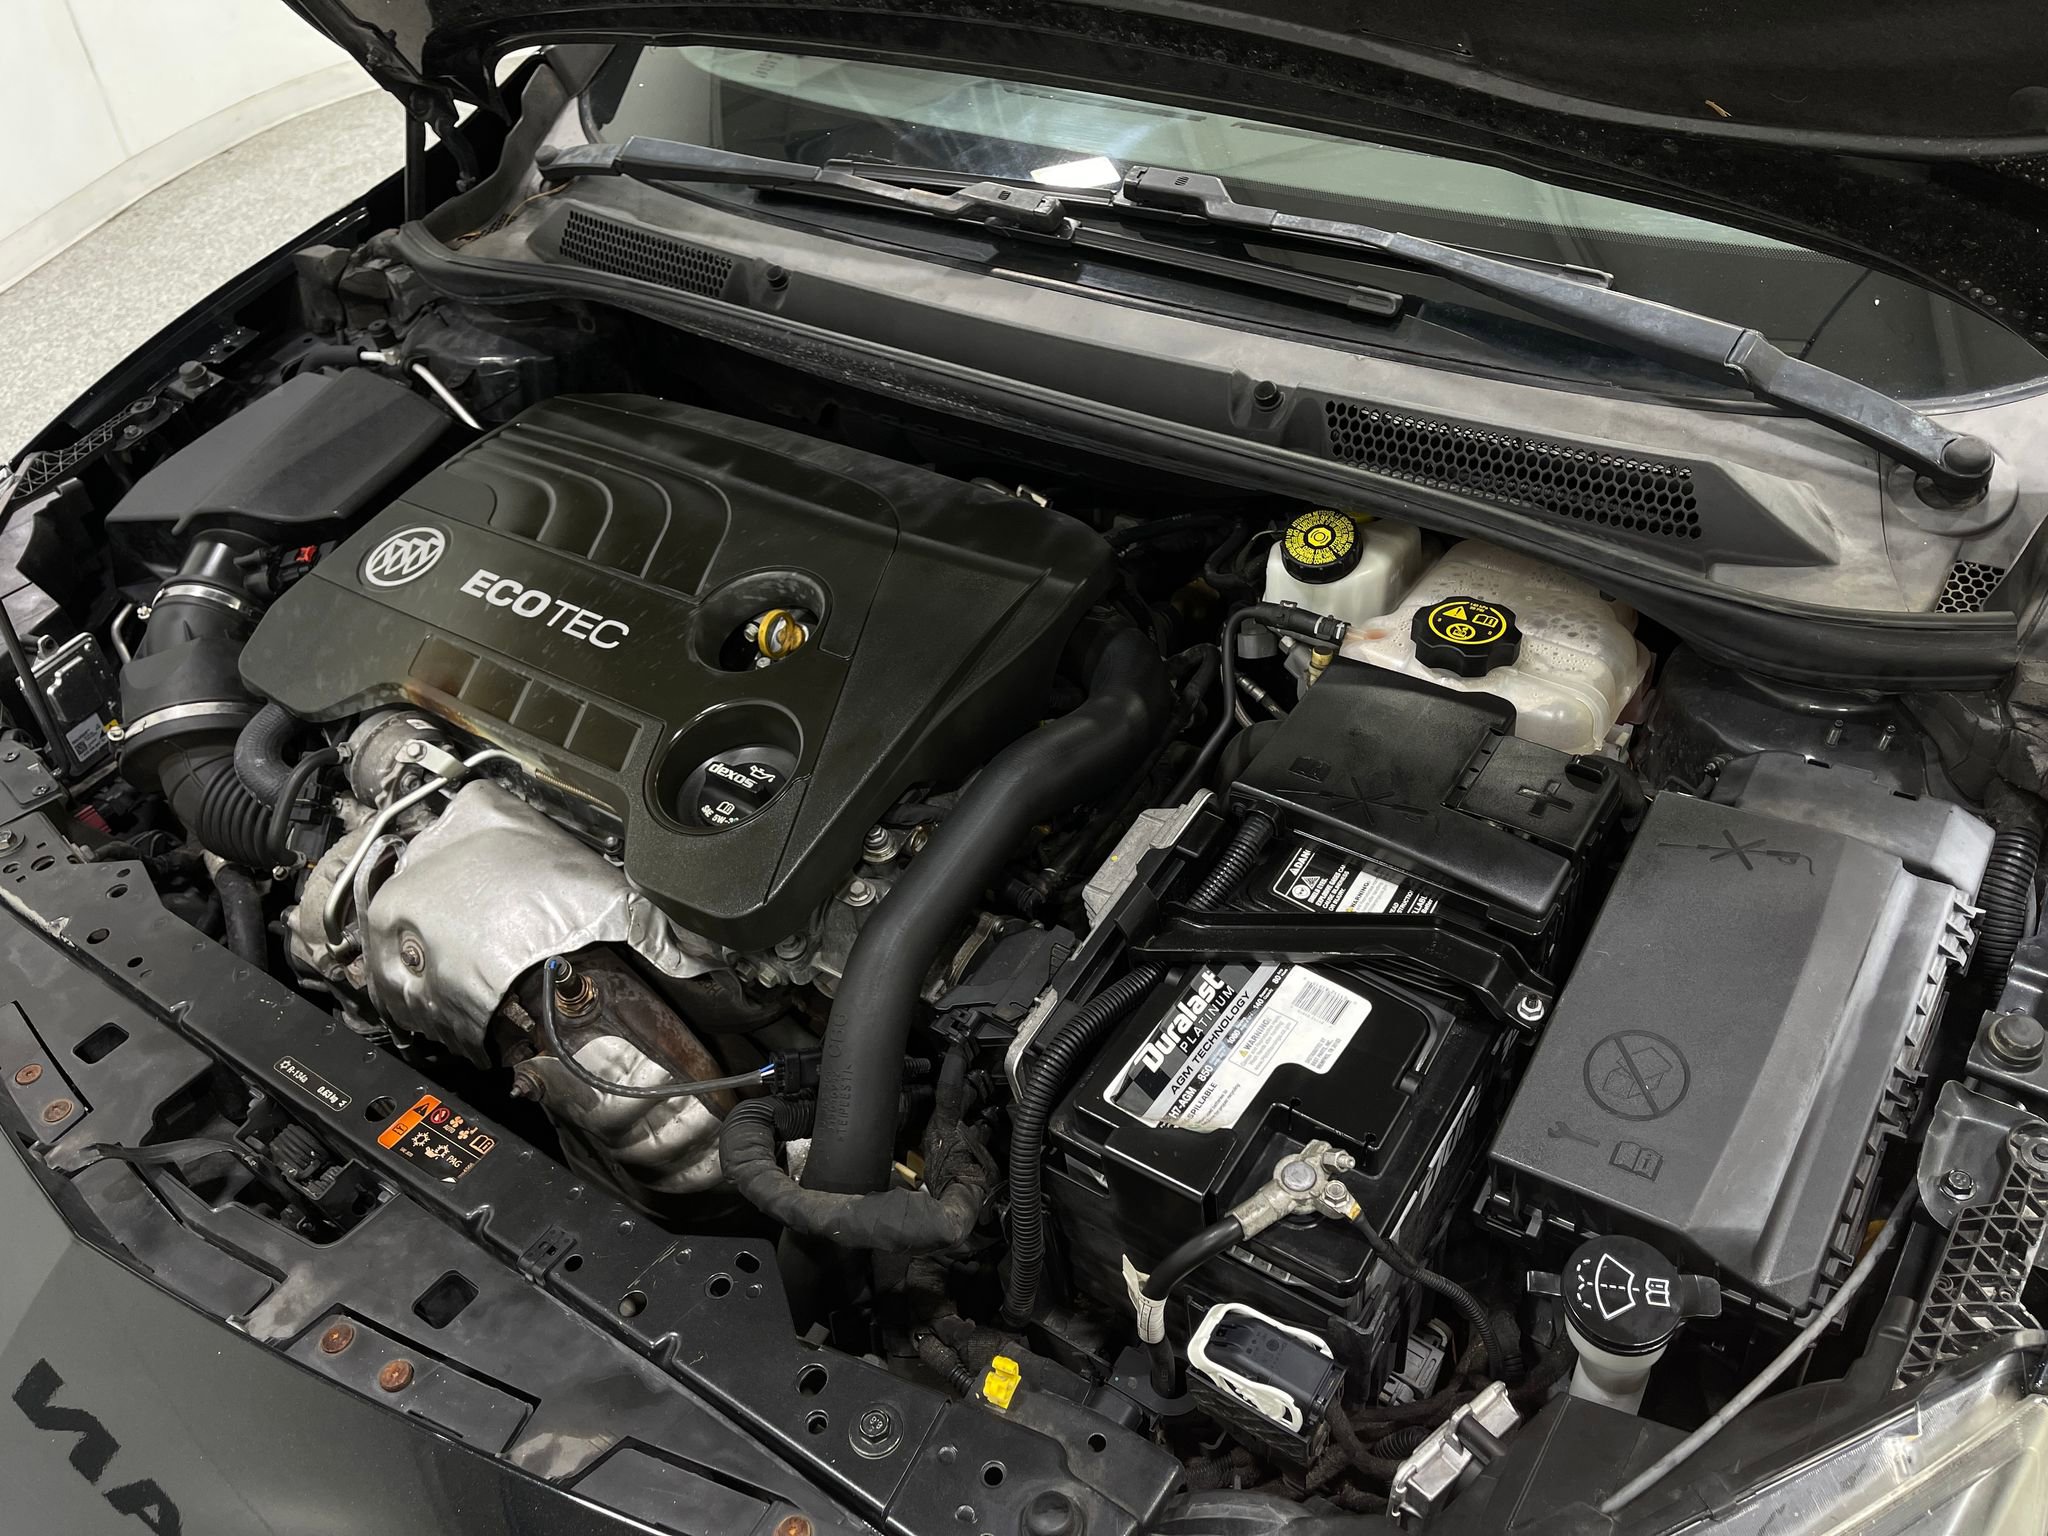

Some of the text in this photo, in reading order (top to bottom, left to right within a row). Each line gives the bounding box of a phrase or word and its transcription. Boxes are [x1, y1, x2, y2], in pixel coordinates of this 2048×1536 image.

[460, 569, 630, 650] ECOTEC
[708, 763, 758, 789] dexos
[1134, 970, 1225, 1073] Duralast
[1168, 1085, 1198, 1120] H7-AGM
[1197, 1063, 1214, 1083] 850
[1253, 998, 1263, 1009] 140
[1272, 974, 1280, 983] 80
[1171, 1066, 1194, 1095] AGM
[1191, 991, 1251, 1064] TECHNOLOGY
[1180, 985, 1235, 1053] PLATINUM
[286, 1065, 308, 1083] R-134a
[446, 1155, 462, 1168] PAG
